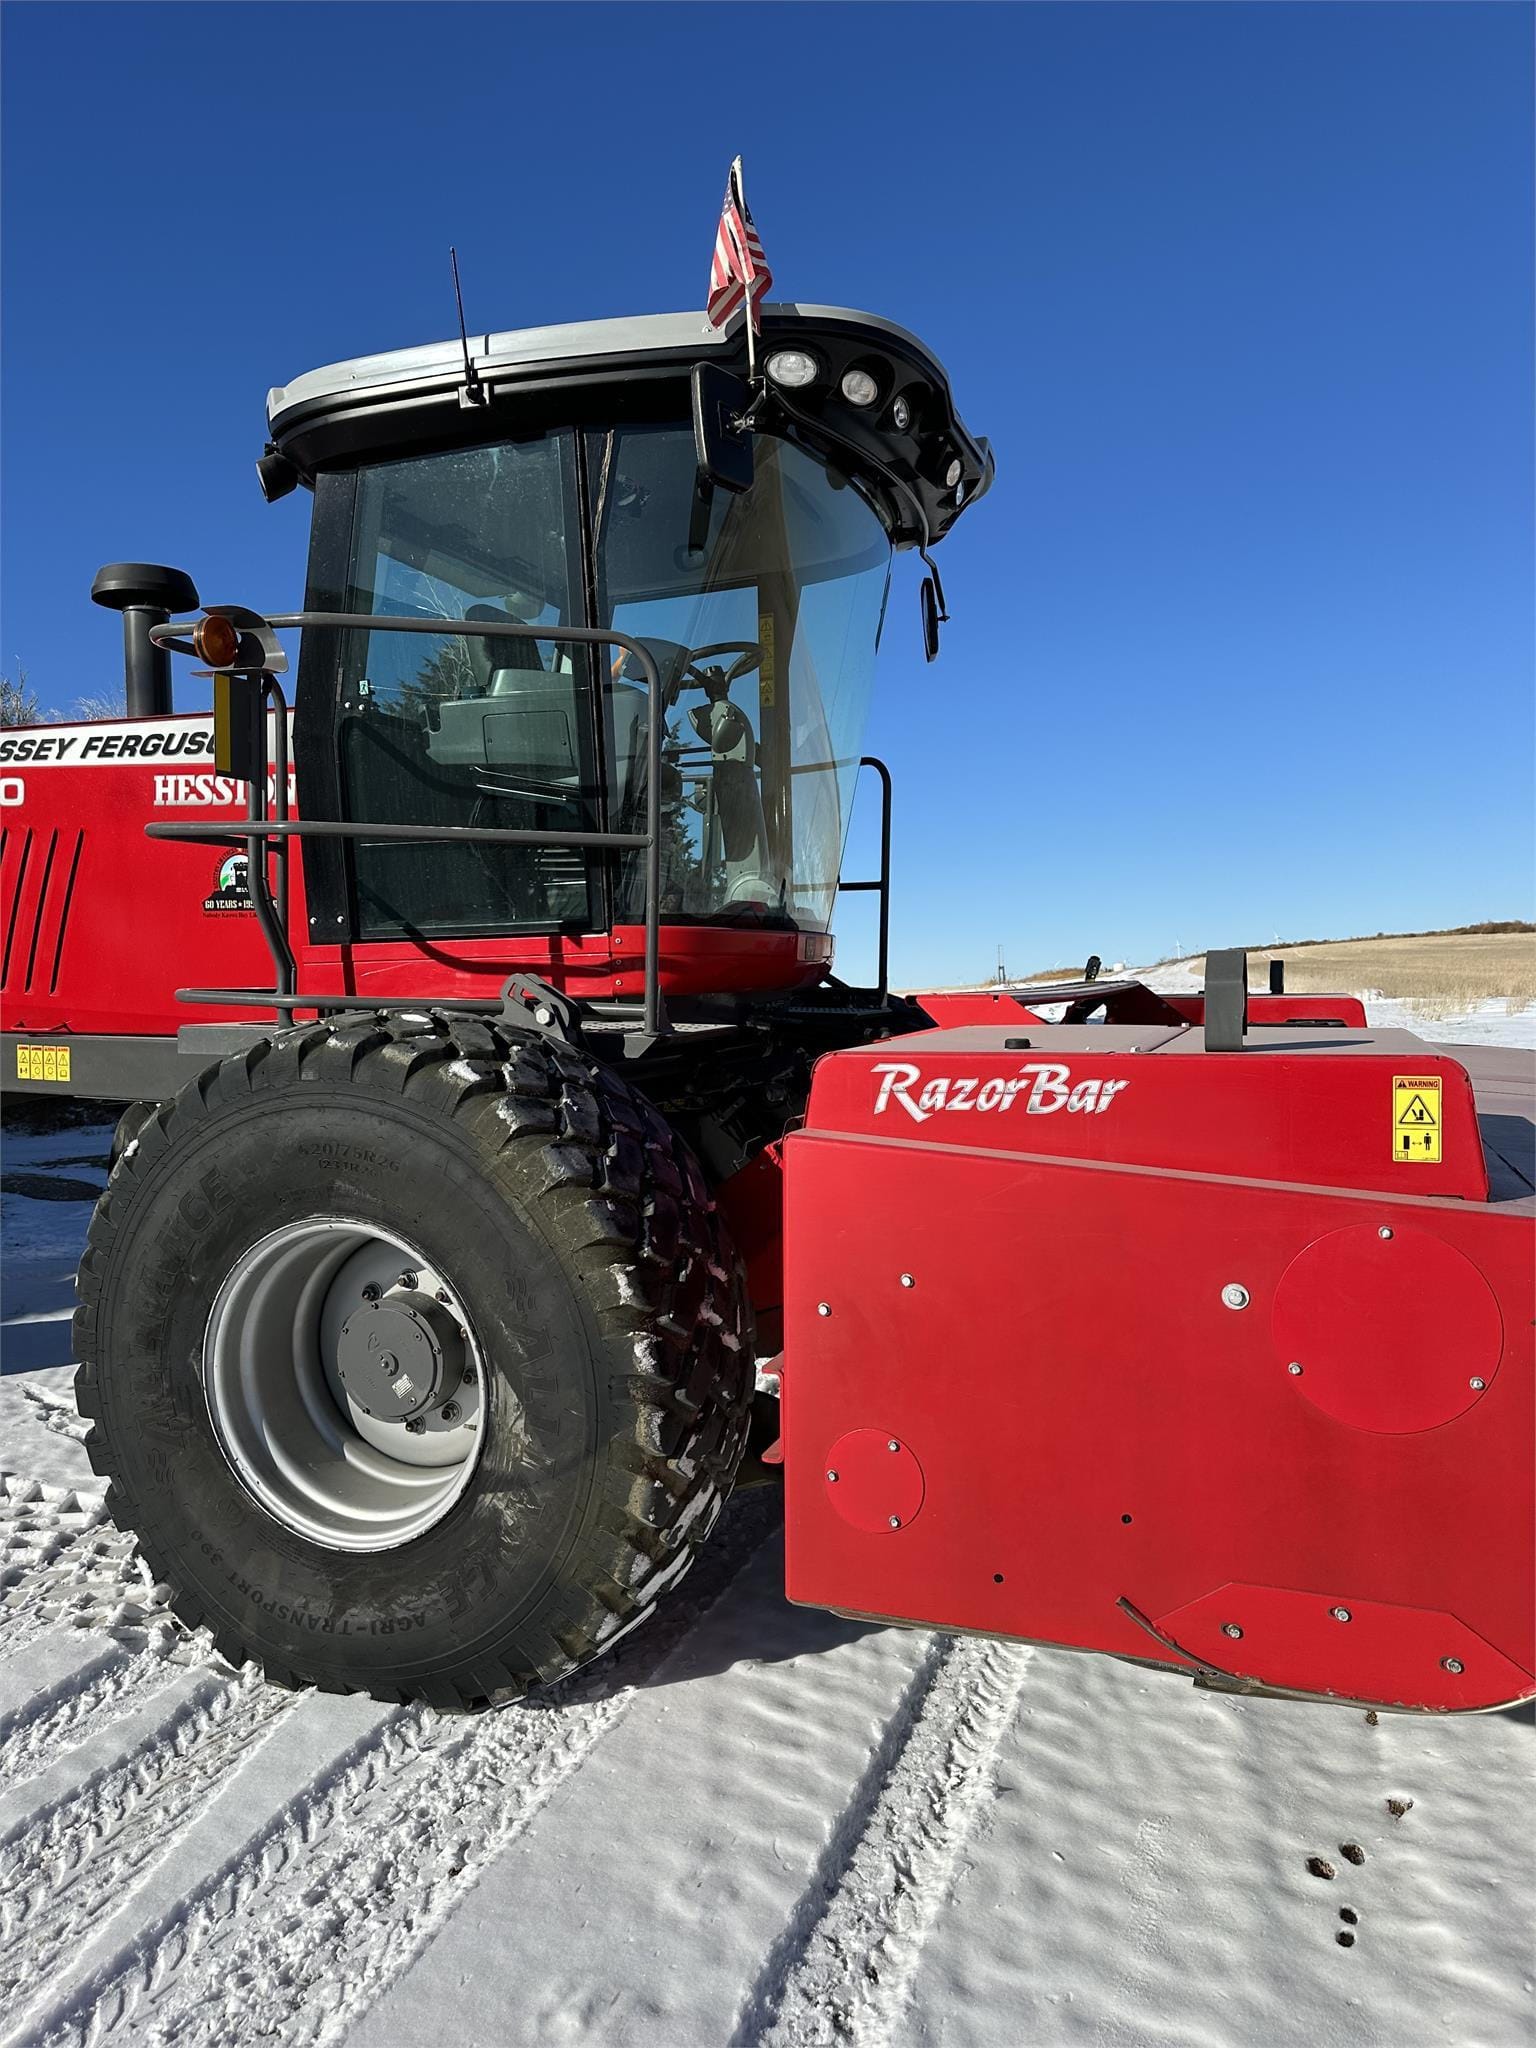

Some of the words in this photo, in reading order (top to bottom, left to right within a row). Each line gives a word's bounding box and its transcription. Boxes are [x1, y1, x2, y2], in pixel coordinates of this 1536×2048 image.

[215, 899, 238, 909] YEARS
[1407, 1080, 1438, 1088] WARNING
[870, 1062, 1031, 1124] Razor
[1019, 1063, 1131, 1115] Bar
